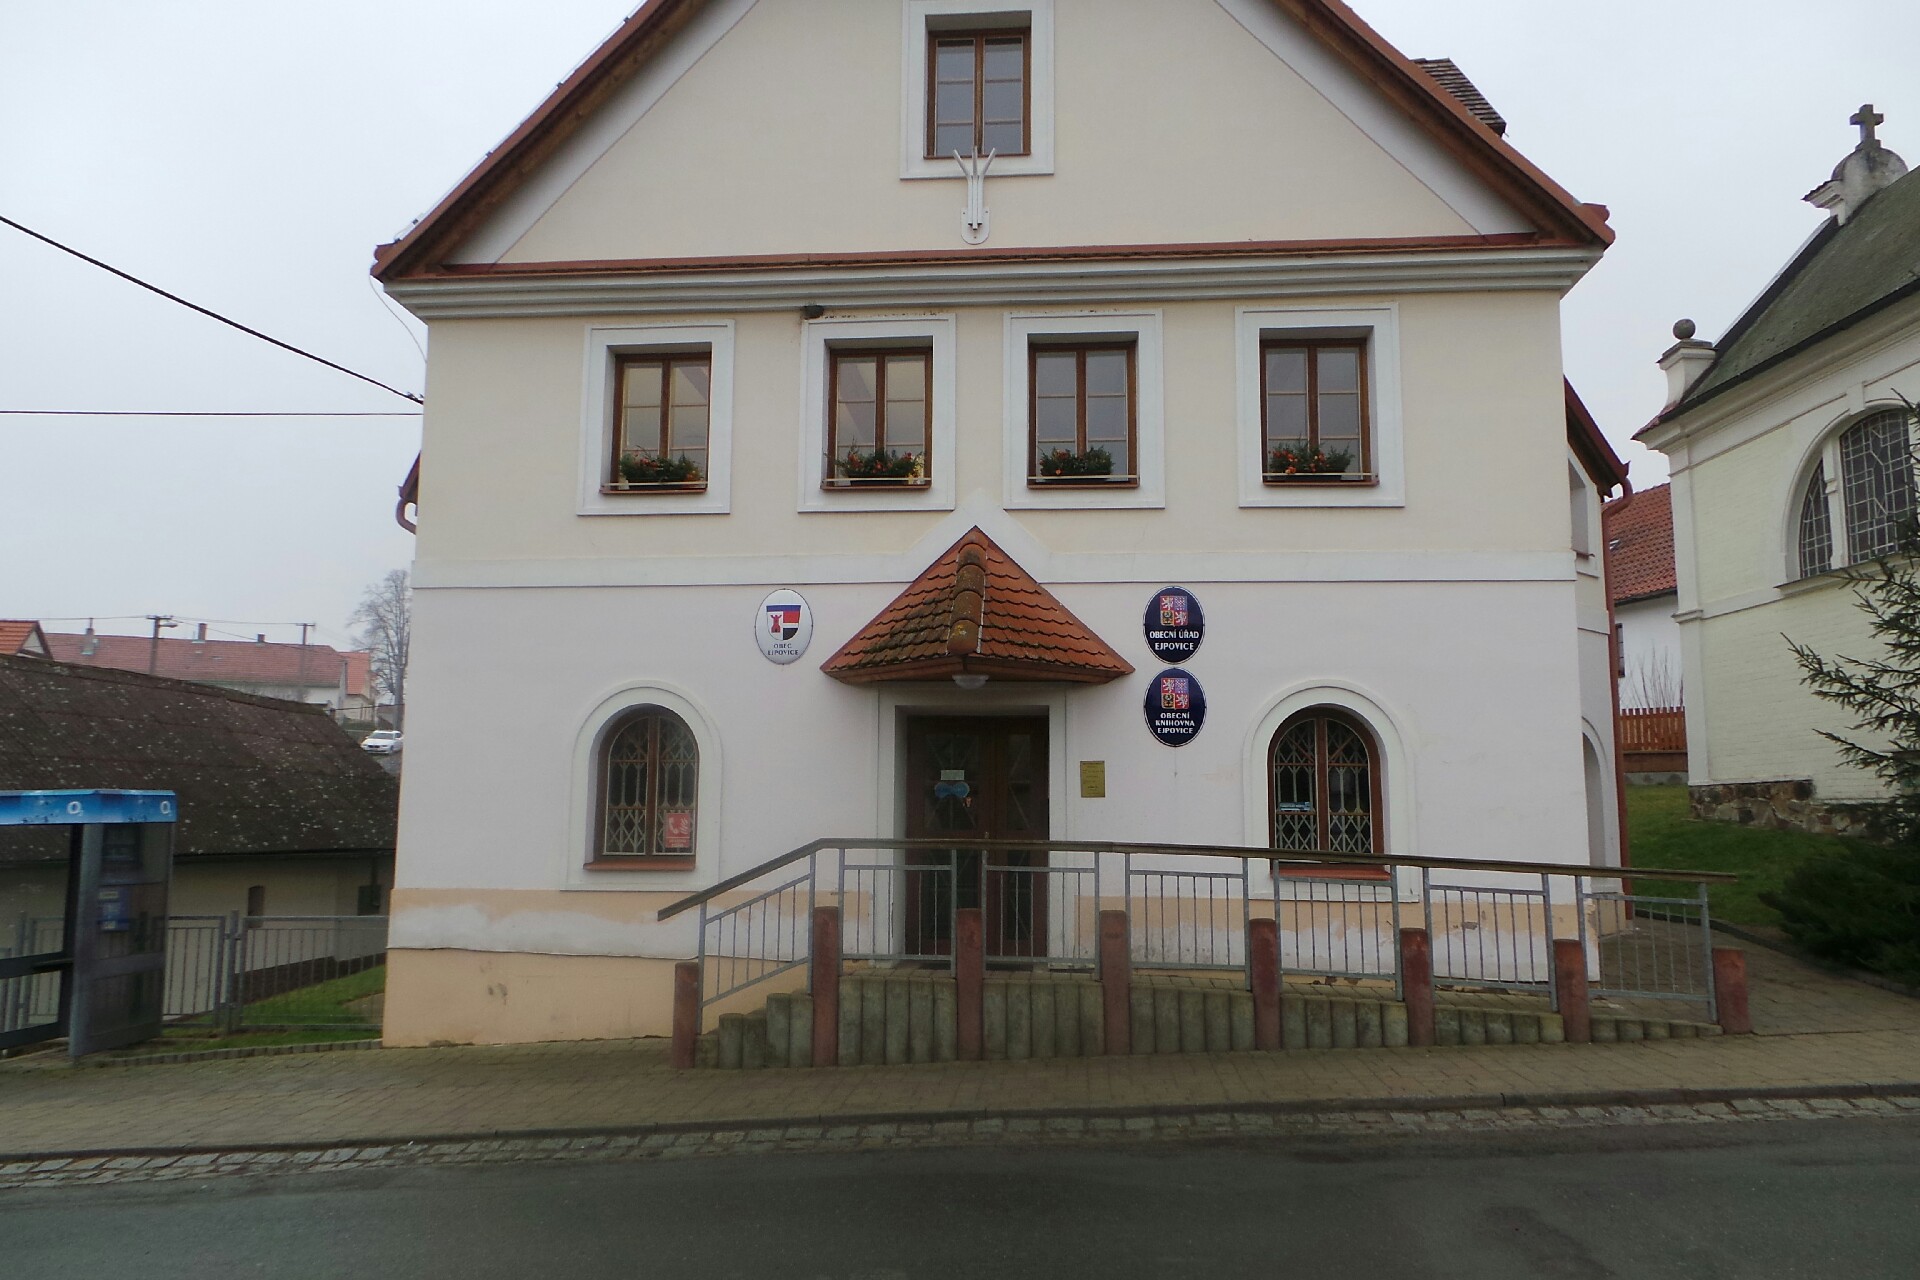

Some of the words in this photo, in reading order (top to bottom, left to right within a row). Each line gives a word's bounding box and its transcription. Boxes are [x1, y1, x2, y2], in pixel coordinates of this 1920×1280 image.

[1149, 628, 1177, 639] OBECNÍ
[1178, 628, 1200, 639] ÚŘAD
[1154, 642, 1194, 651] EJPOVICE
[1160, 711, 1190, 719] OBECNÍ
[1155, 719, 1195, 727] KNIHOVNA
